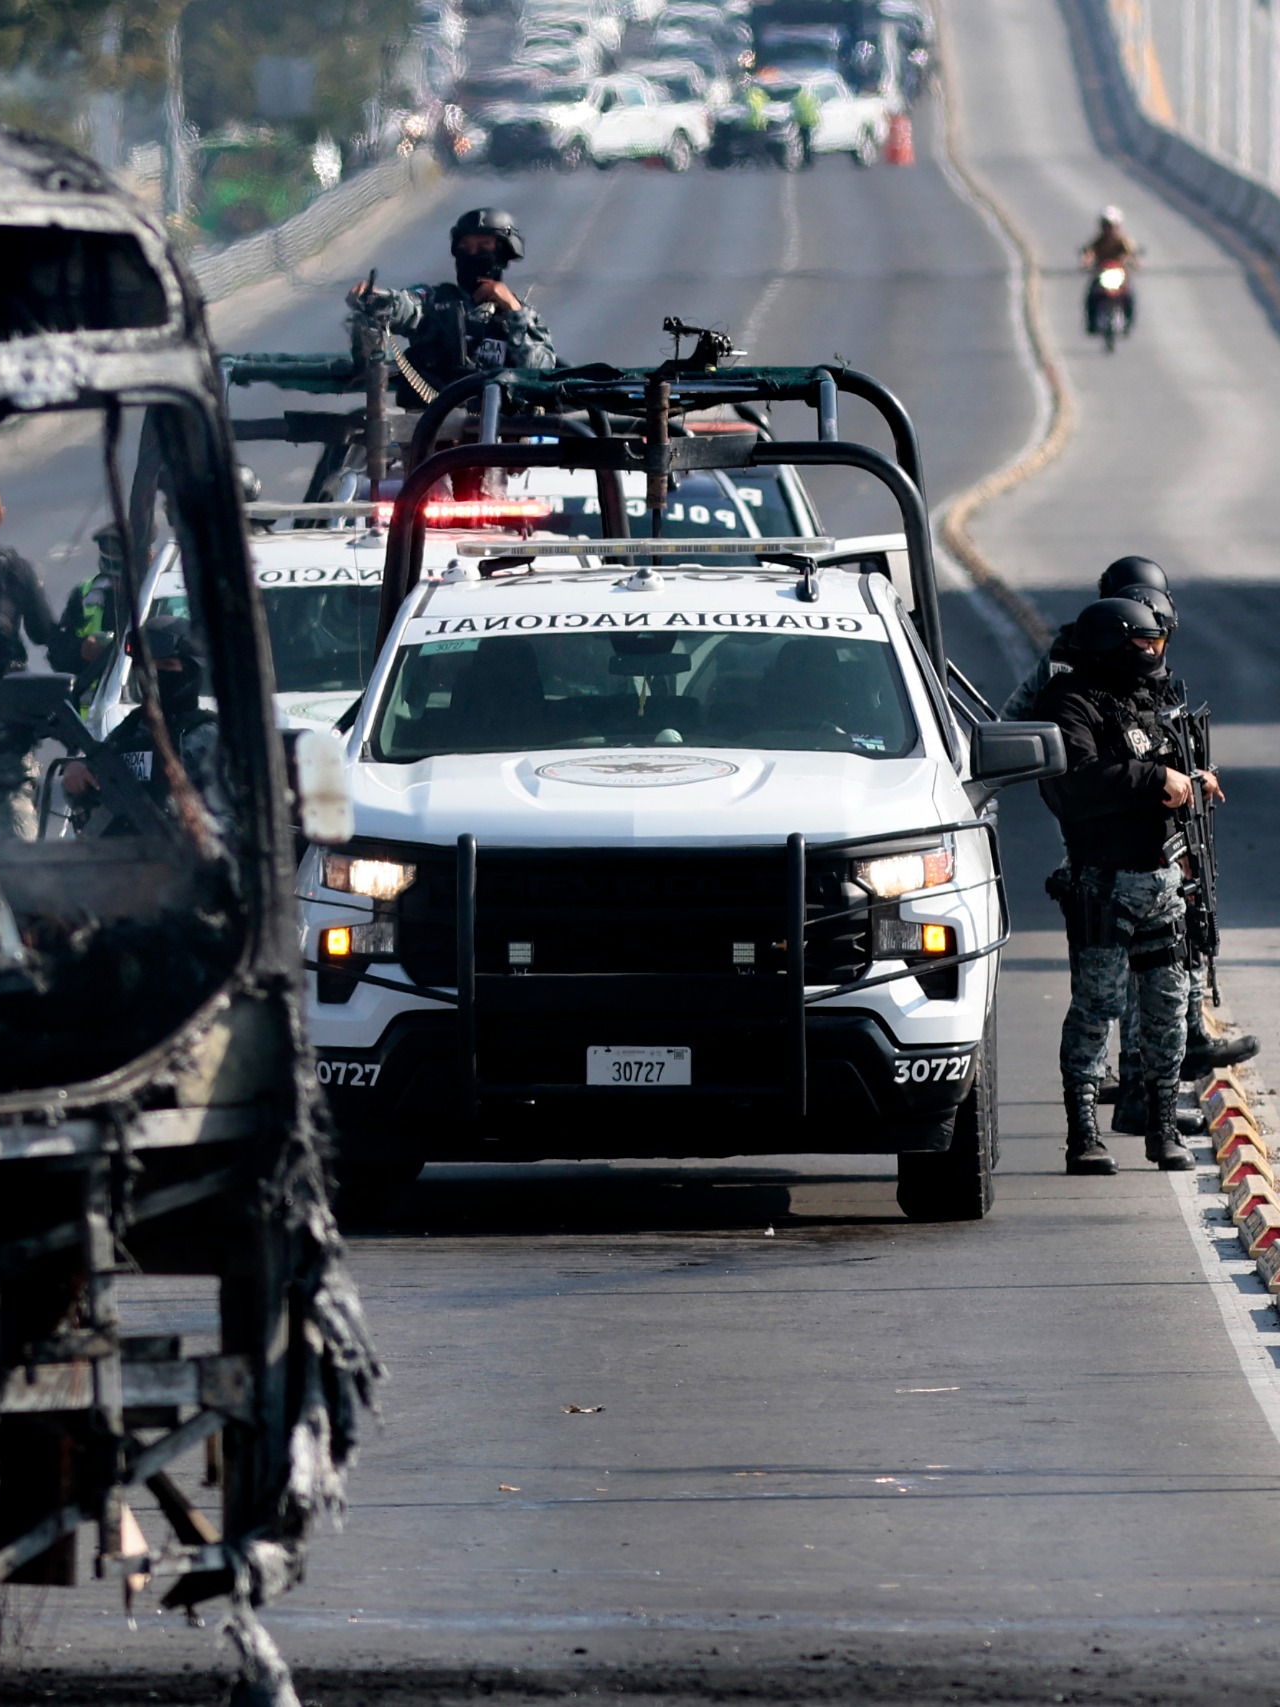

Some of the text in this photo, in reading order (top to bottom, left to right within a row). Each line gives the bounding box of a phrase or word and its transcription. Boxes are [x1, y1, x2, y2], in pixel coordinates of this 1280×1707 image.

[316, 1060, 381, 1087] 0727
[612, 1061, 665, 1083] 30727
[893, 1055, 971, 1084] 30727
